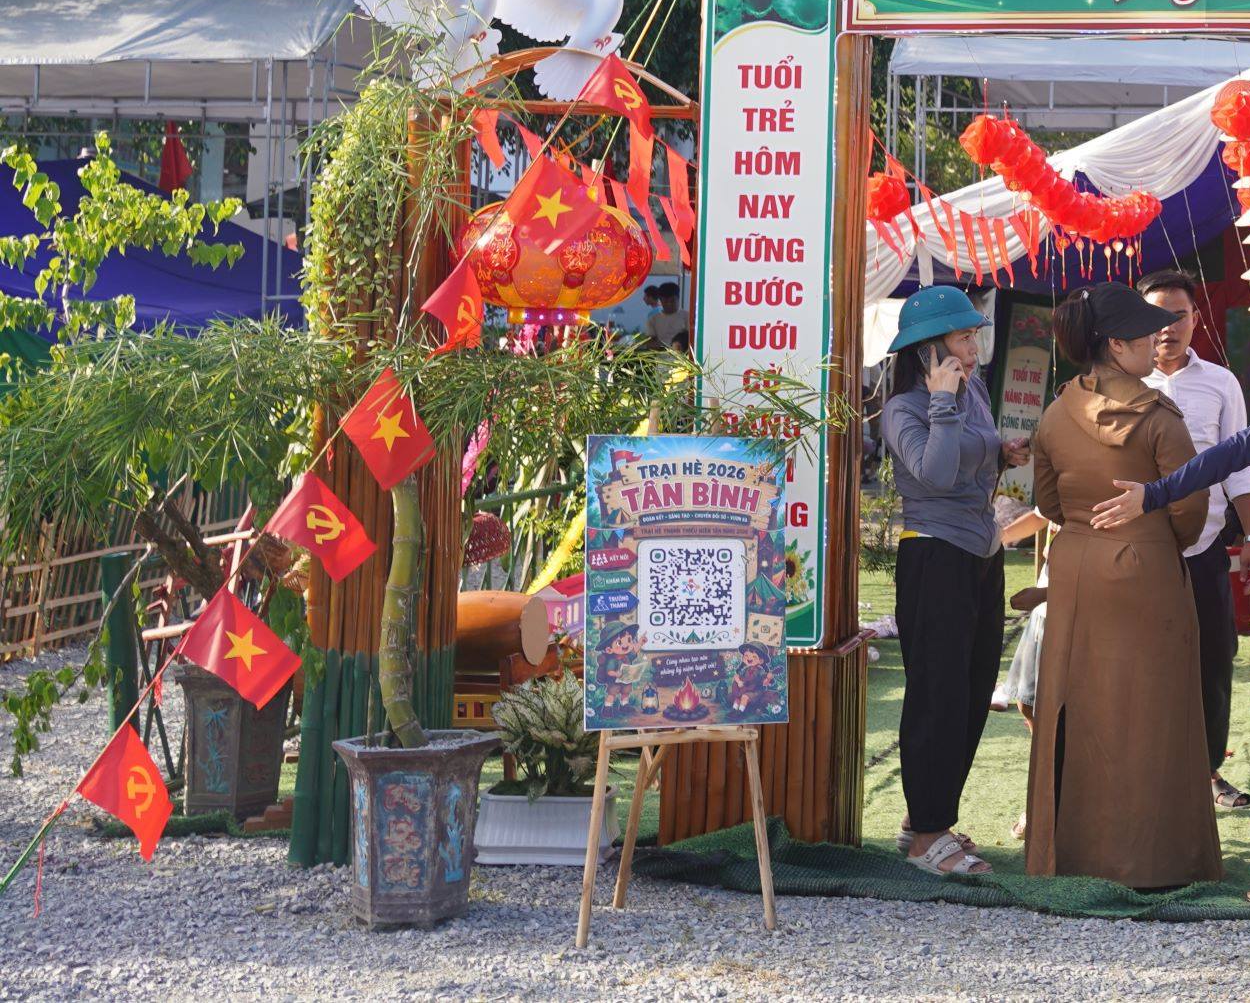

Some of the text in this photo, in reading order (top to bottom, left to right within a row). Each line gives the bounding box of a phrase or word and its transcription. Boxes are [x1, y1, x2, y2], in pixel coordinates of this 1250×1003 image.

[737, 55, 802, 89] TUỔI
[742, 100, 795, 132] TRẺ
[734, 146, 801, 175] HÔM
[738, 195, 795, 219] NAY
[726, 233, 804, 263] VỮNG
[724, 276, 804, 306] BƯỚC
[728, 320, 797, 350] DƯỚI
[1029, 368, 1042, 383] TRẺ
[637, 459, 746, 480] TRẠI HÈ 2026
[621, 478, 761, 513] TÂN BÌNH
